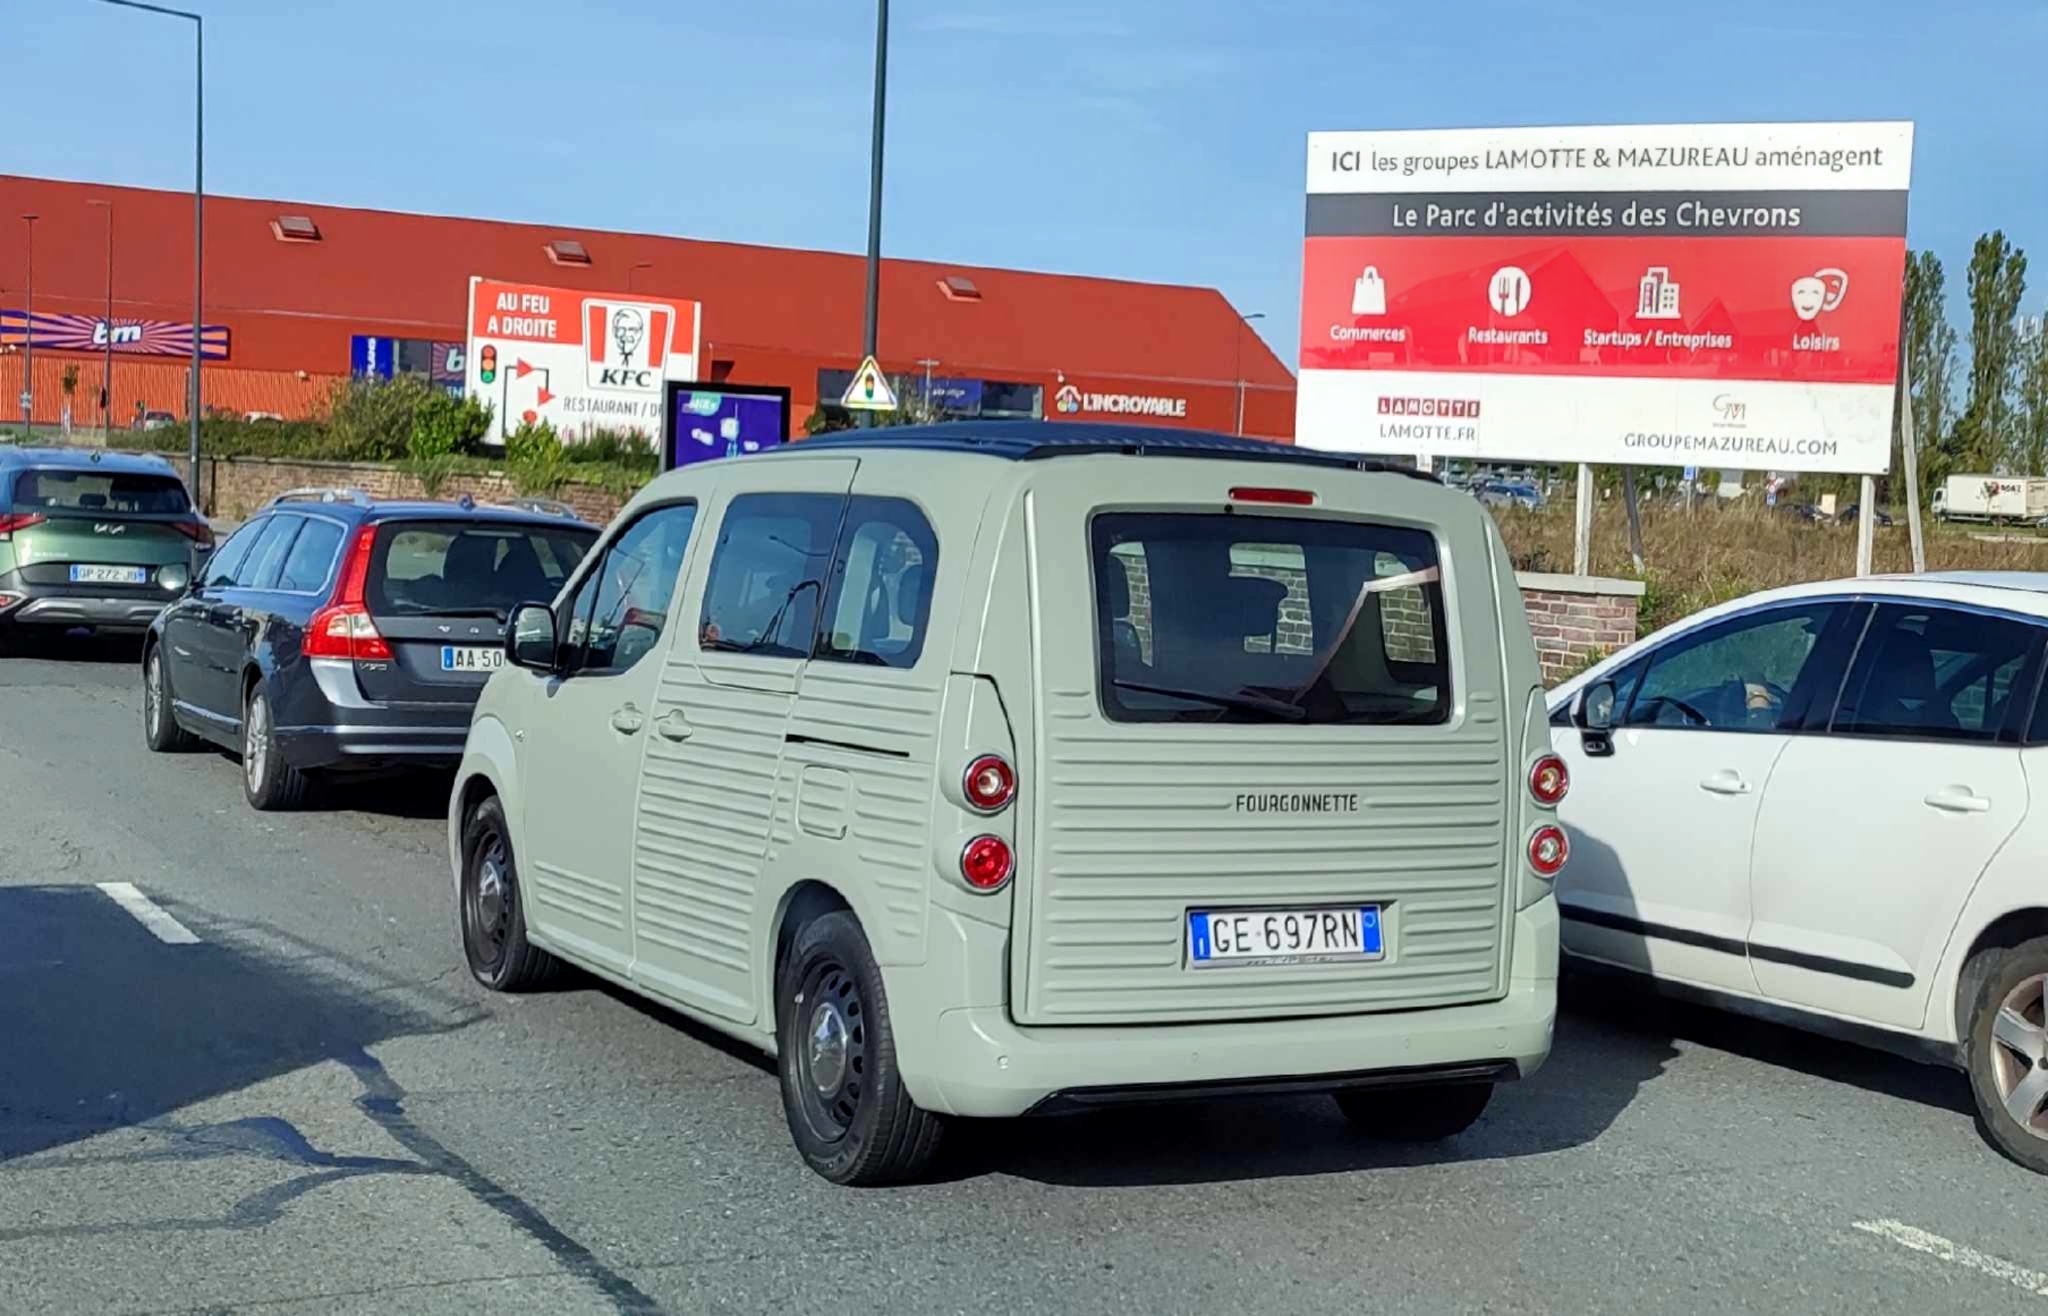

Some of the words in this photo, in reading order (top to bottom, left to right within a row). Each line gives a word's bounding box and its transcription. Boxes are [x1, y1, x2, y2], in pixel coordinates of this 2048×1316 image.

[1331, 151, 1361, 172] ICI
[1371, 150, 1398, 171] les
[1402, 152, 1479, 176] groupes
[1485, 148, 1587, 170] LAMOTTE
[1593, 148, 1611, 168] &
[1617, 147, 1749, 168] MAZUREAU
[1755, 145, 1883, 173] aménagent
[1393, 204, 1418, 227] Le
[1426, 203, 1476, 227] Parc
[1484, 201, 1613, 227] d'activités
[1621, 200, 1667, 227] des
[1676, 200, 1802, 227] Chevrons
[496, 292, 519, 312] AU
[522, 295, 550, 314] FEU
[487, 315, 499, 334] A
[502, 317, 557, 339] DROITE
[1330, 325, 1406, 342] Commerces
[1468, 326, 1548, 344] Restaurants
[1583, 328, 1642, 347] Startups
[1655, 330, 1733, 352] Entreprises
[1792, 333, 1840, 350] Loisirs
[600, 368, 651, 388] KFC
[563, 397, 637, 417] RESTAURANT
[1083, 393, 1186, 416] L'INCROYABLE
[1377, 396, 1480, 418] LAMOTTE
[1379, 423, 1475, 441] LAMOTTE.FR
[1624, 432, 1838, 456] GROUPEMAZUREAU.COM
[1236, 794, 1358, 812] FOURGONNETTE
